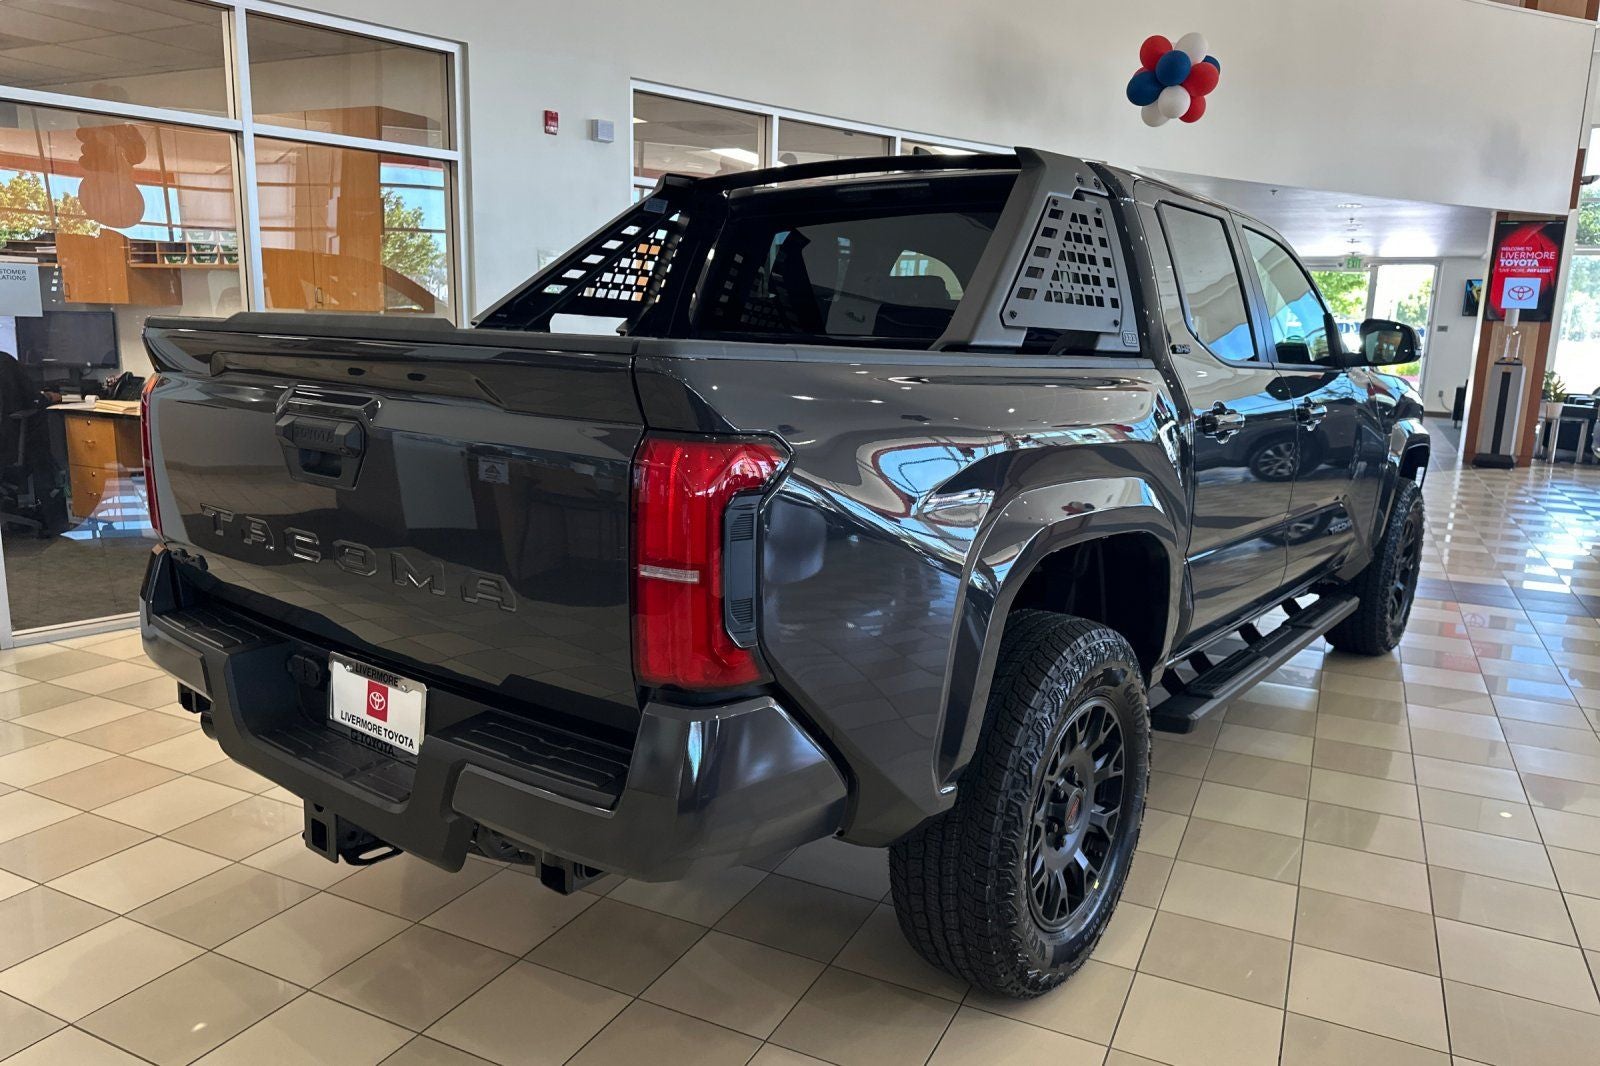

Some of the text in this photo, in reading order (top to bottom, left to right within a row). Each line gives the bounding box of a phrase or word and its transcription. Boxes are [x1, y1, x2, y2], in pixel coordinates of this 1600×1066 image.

[1500, 251, 1555, 259] LIVERMORE
[1500, 259, 1539, 267] TOYOTA
[199, 502, 517, 613] TACOMA
[355, 662, 399, 687] LIVERMORE
[341, 710, 415, 749] LIVERMORE TOYOTA
[359, 732, 396, 757] TOYOTA
